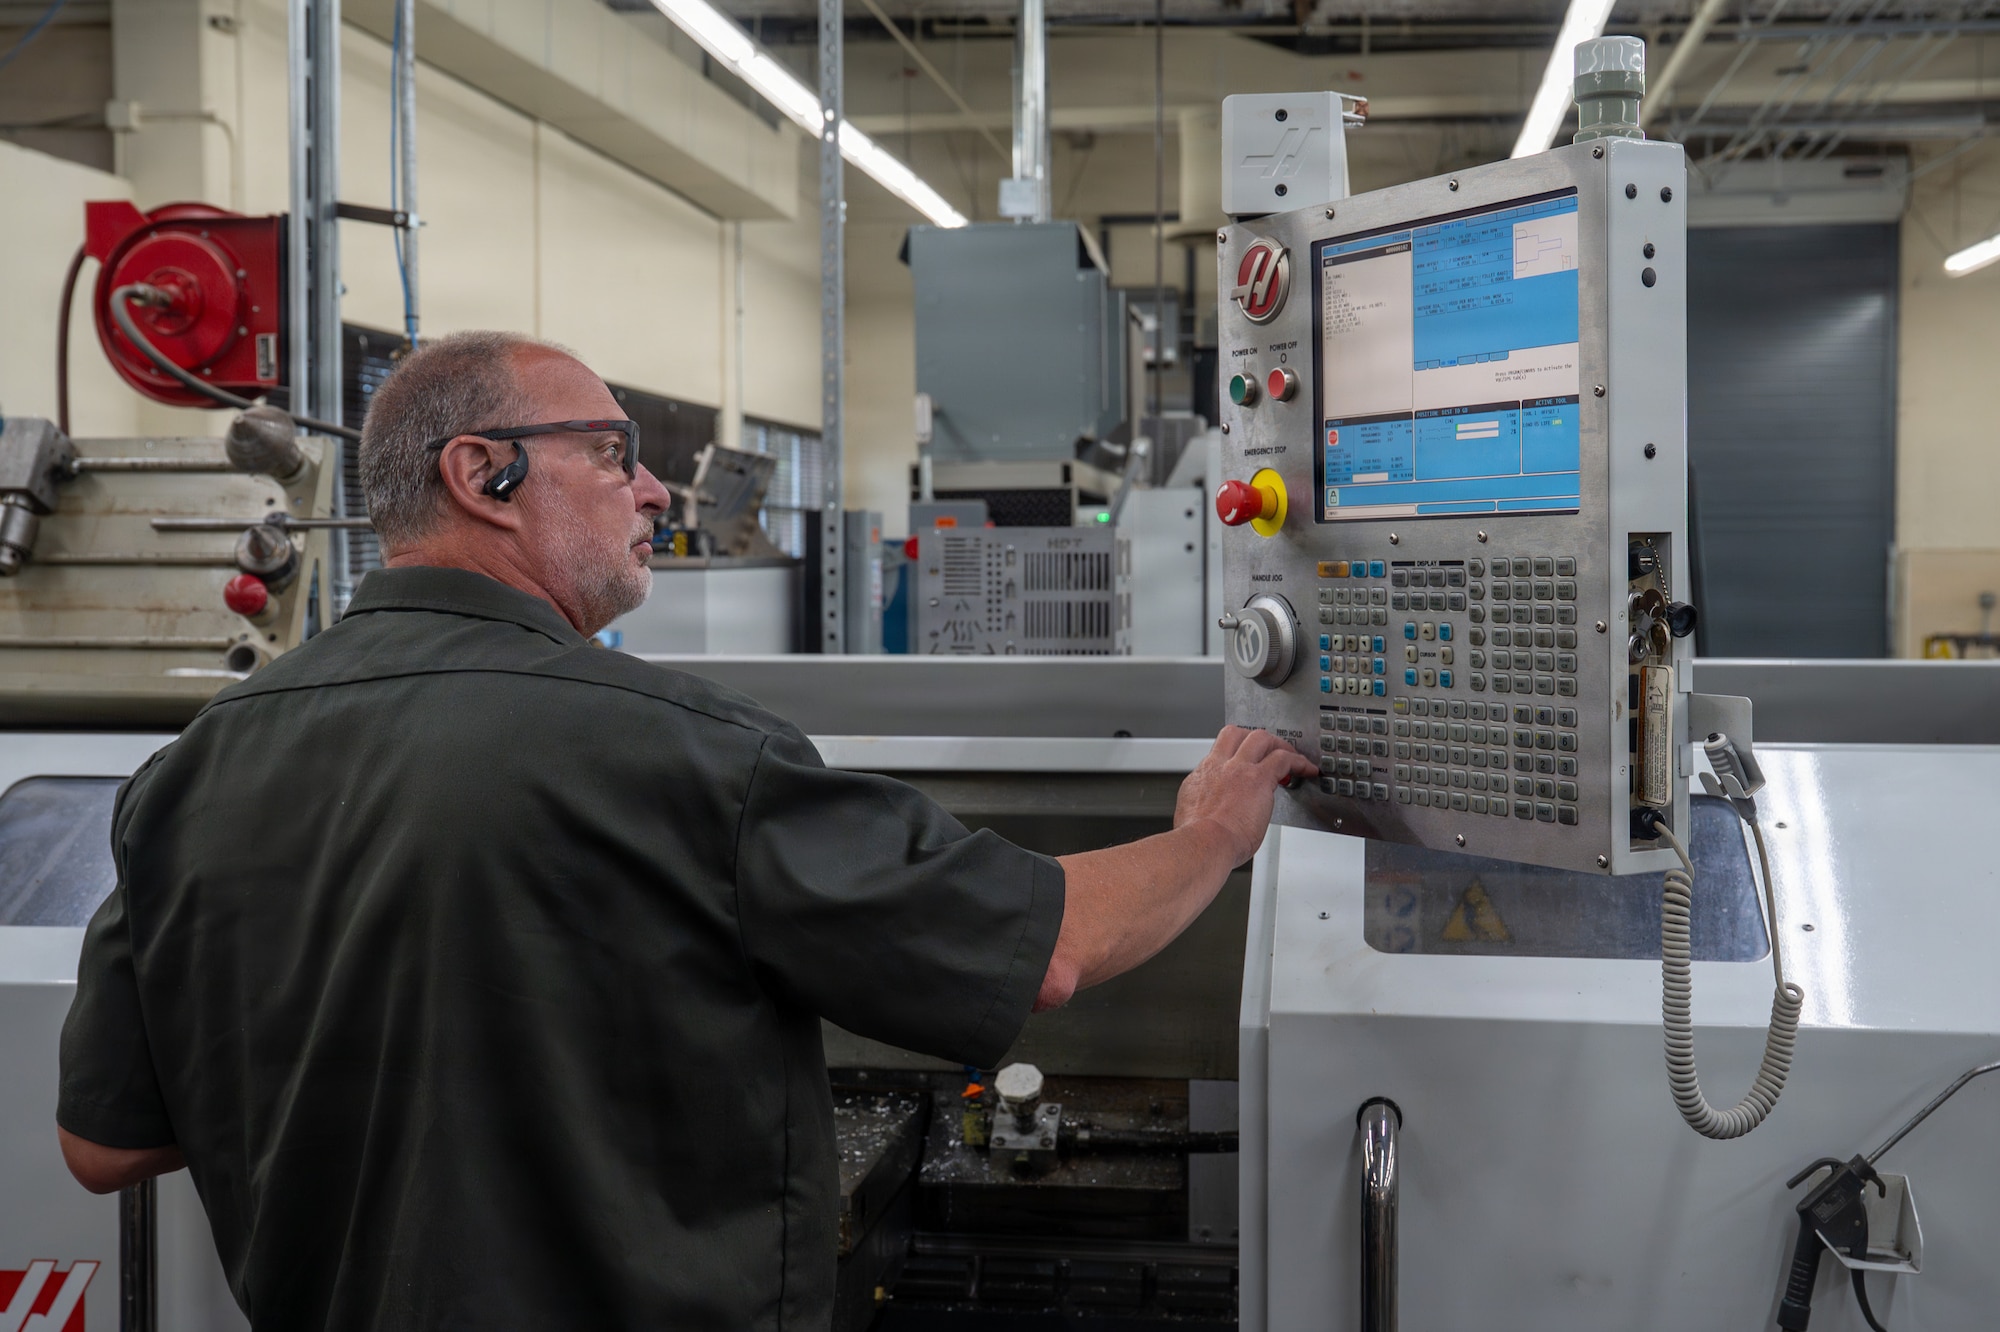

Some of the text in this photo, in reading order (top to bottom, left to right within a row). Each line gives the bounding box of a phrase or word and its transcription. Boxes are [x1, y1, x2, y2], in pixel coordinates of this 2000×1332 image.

[1518, 710, 1523, 718] 7
[1540, 712, 1545, 720] 8
[1562, 713, 1567, 721] 9
[1563, 737, 1567, 745] 6
[1540, 760, 1545, 769] 2
[1563, 763, 1568, 771] 3
[1541, 785, 1545, 793] 0
